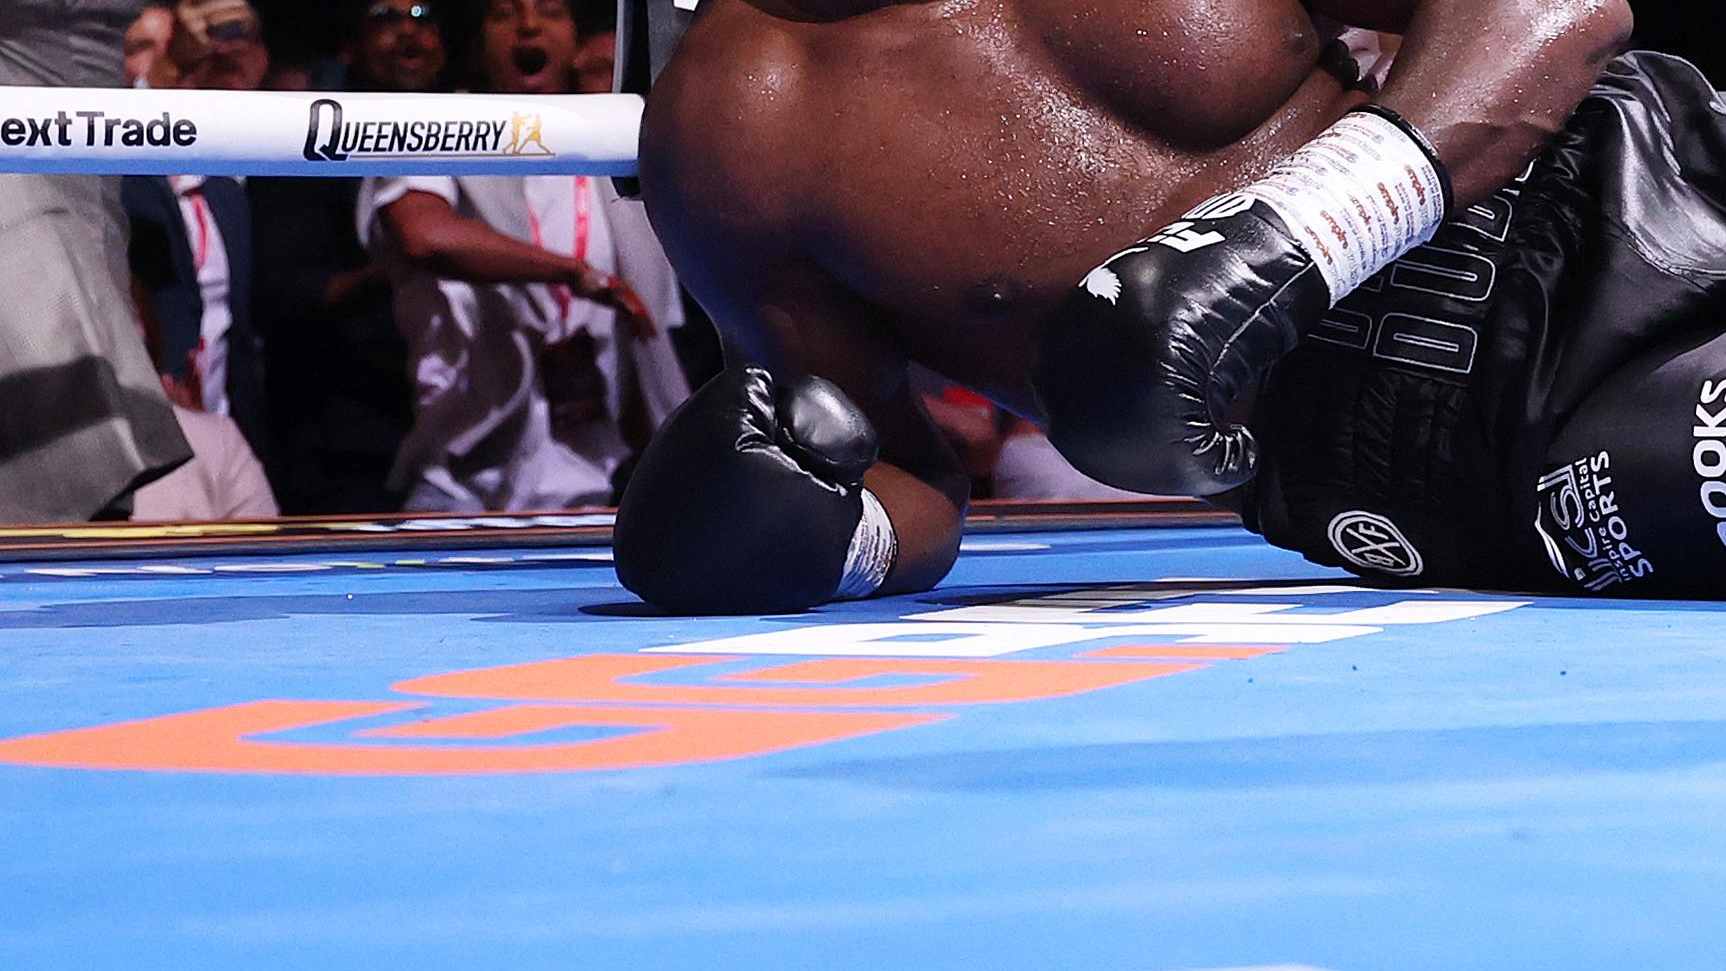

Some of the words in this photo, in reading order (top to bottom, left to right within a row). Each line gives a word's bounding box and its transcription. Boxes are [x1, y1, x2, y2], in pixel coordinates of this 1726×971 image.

[76, 111, 198, 147] Trade
[303, 98, 507, 163] QUEENSBERRY
[1591, 450, 1654, 578] SPORTS
